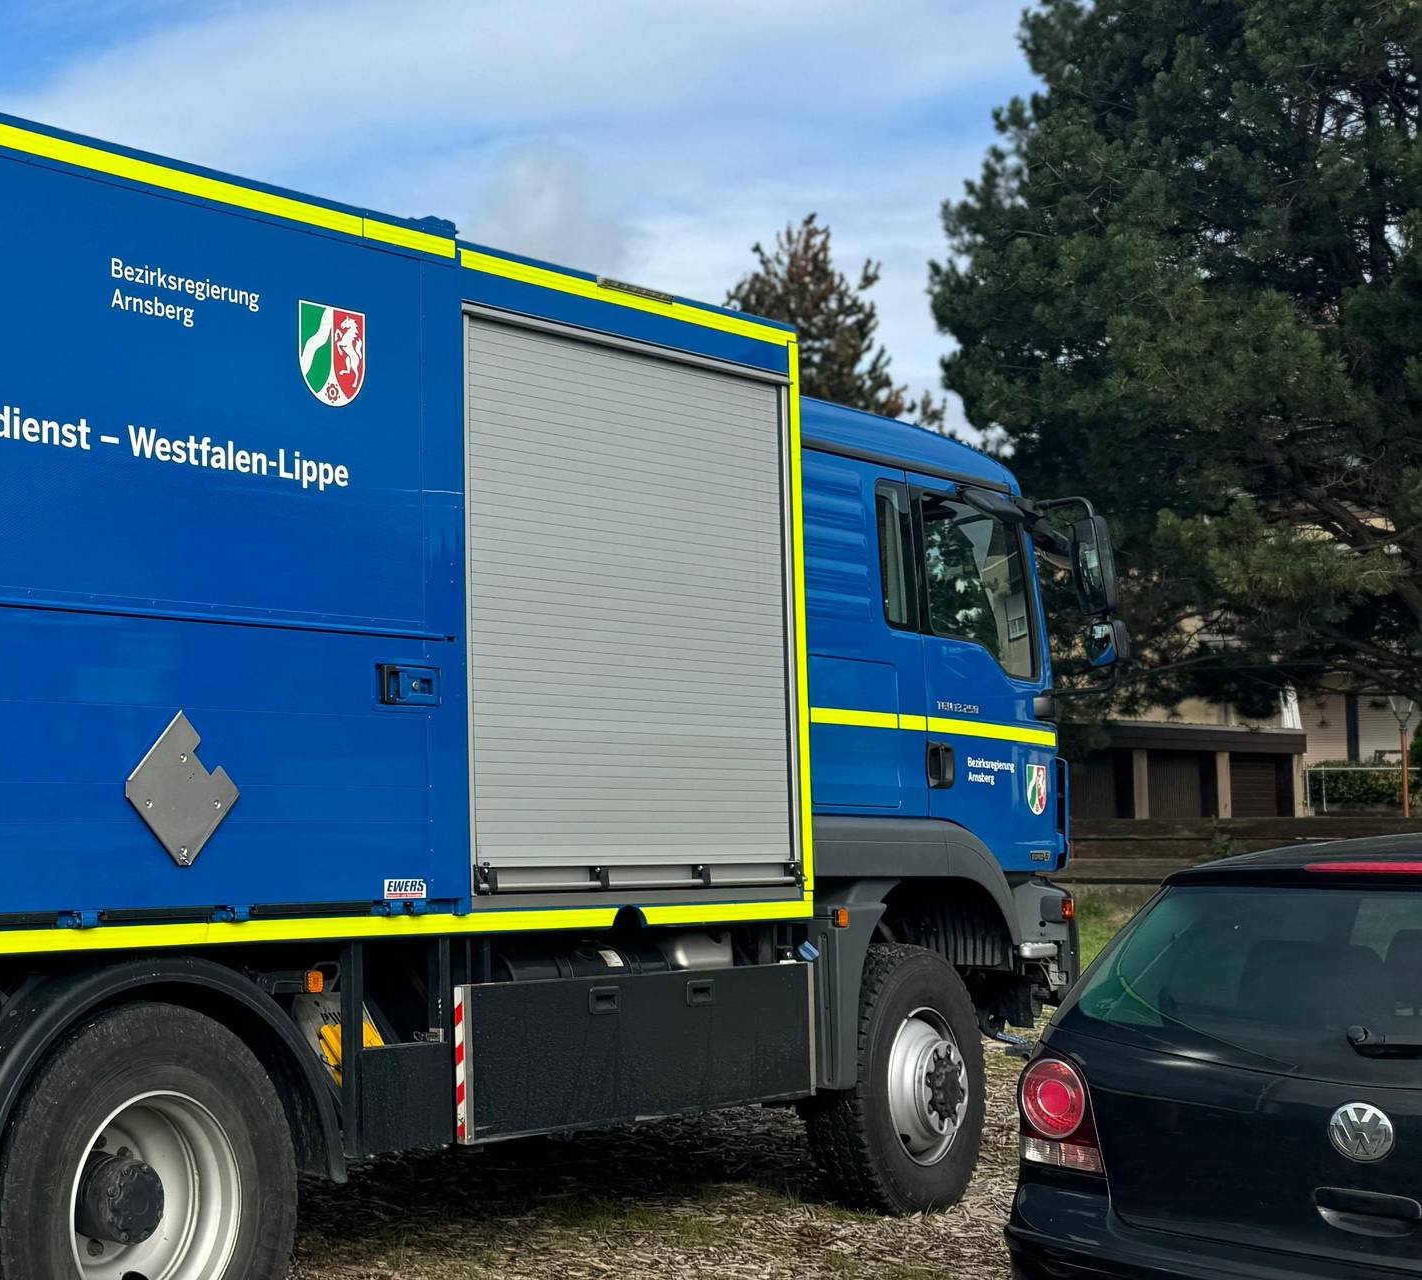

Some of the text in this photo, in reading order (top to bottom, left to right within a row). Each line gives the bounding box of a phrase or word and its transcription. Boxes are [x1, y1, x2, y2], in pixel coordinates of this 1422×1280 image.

[111, 257, 260, 312] Bezirksregierung
[111, 288, 195, 328] Arnsberg
[127, 424, 349, 491] Westfalen-Lippe
[967, 756, 1015, 774] Bezirksregierung
[967, 771, 995, 786] Arnsberg
[386, 880, 425, 892] EWERS
